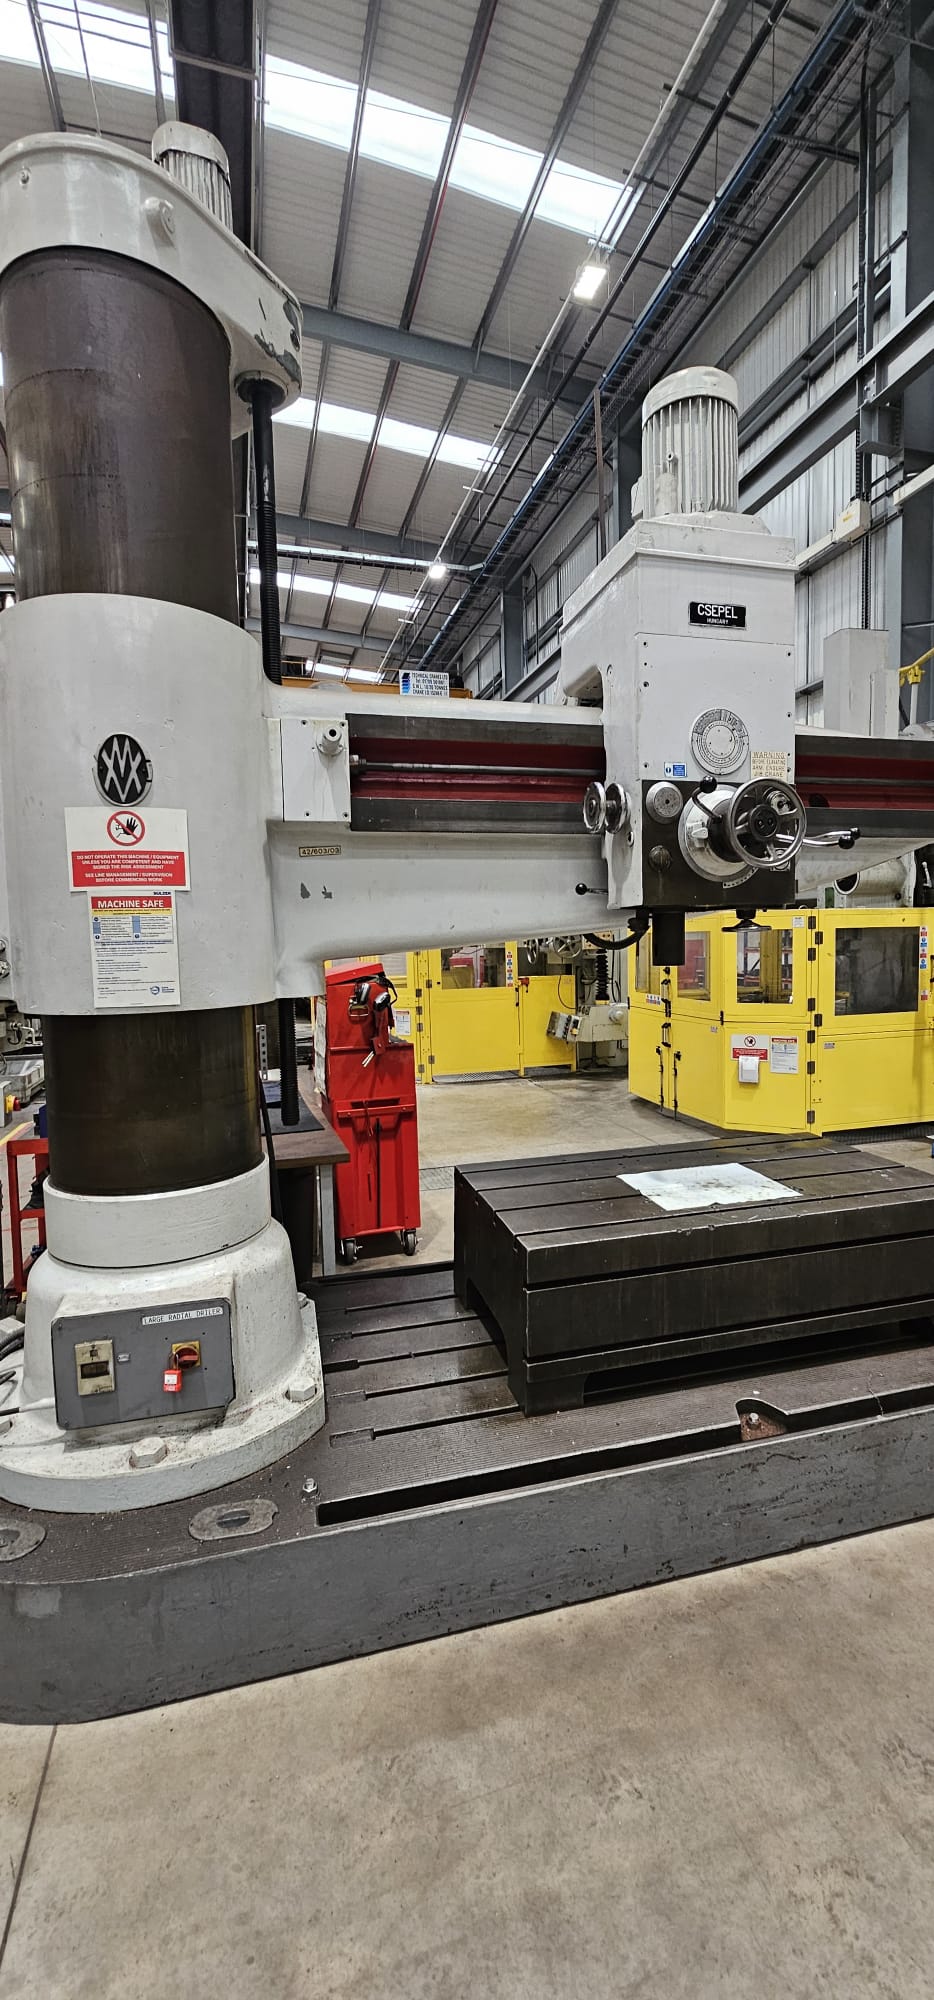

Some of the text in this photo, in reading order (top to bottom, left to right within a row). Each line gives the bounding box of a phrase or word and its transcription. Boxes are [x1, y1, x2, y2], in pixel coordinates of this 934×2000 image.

[697, 603, 738, 619] CSEPEL
[144, 1316, 164, 1325] LARGE
[168, 1312, 192, 1321] RADIAL
